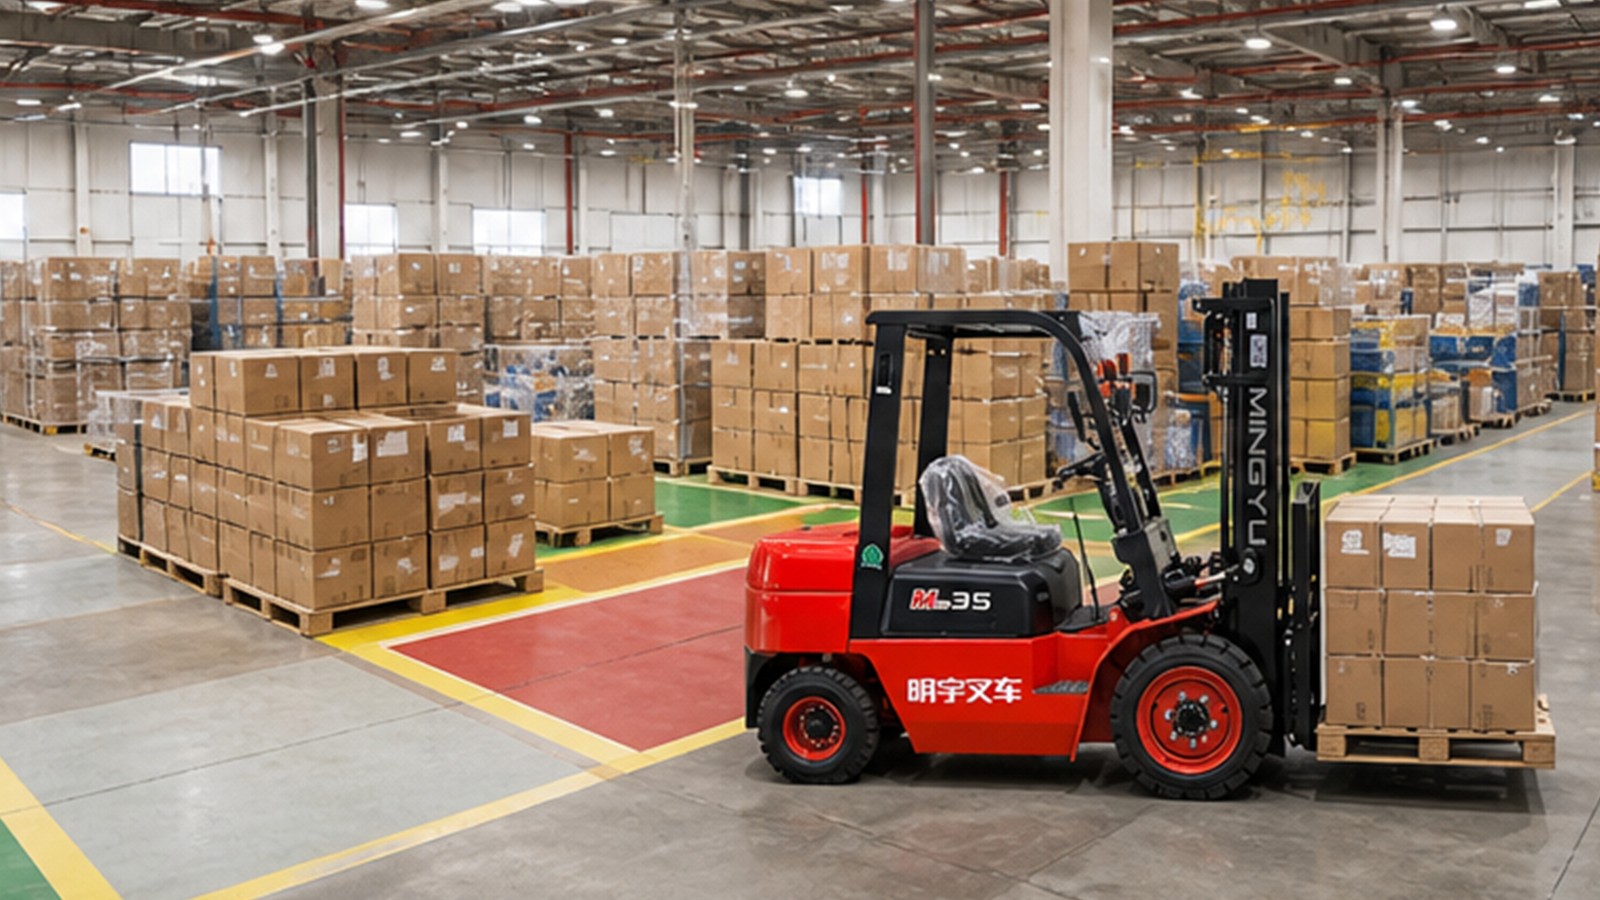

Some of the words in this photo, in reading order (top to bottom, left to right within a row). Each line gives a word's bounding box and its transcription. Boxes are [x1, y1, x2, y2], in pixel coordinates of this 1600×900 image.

[1247, 387, 1268, 546] MINGYU
[907, 676, 1023, 704] 明宇叉车
